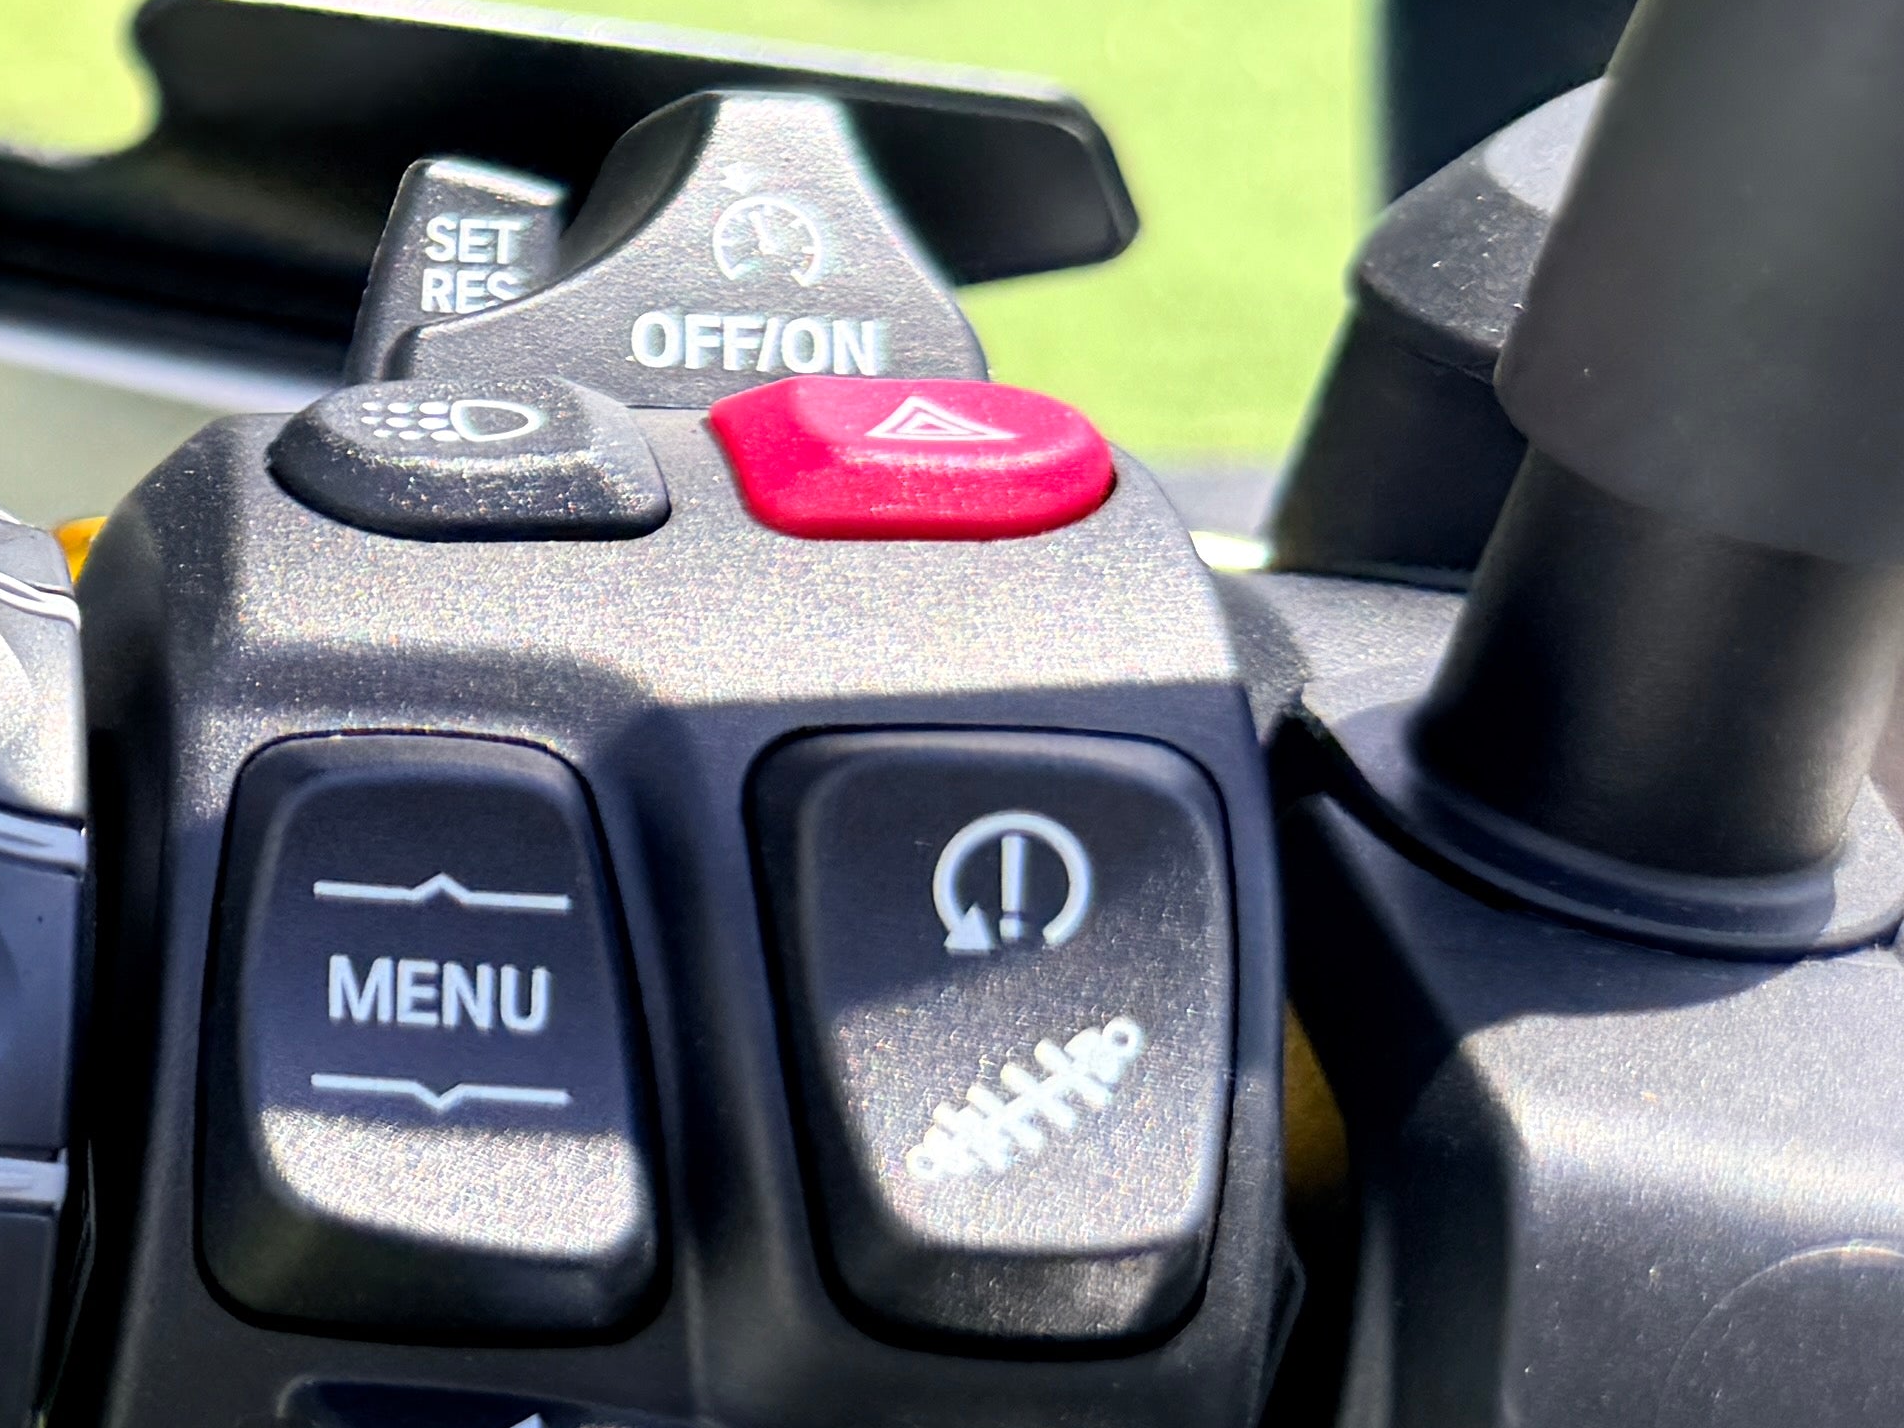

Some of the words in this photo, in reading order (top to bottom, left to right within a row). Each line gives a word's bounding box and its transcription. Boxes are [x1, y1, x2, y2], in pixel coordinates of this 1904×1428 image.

[424, 216, 524, 265] SET
[630, 311, 882, 376] OFF/ON
[327, 953, 551, 1034] MENU
